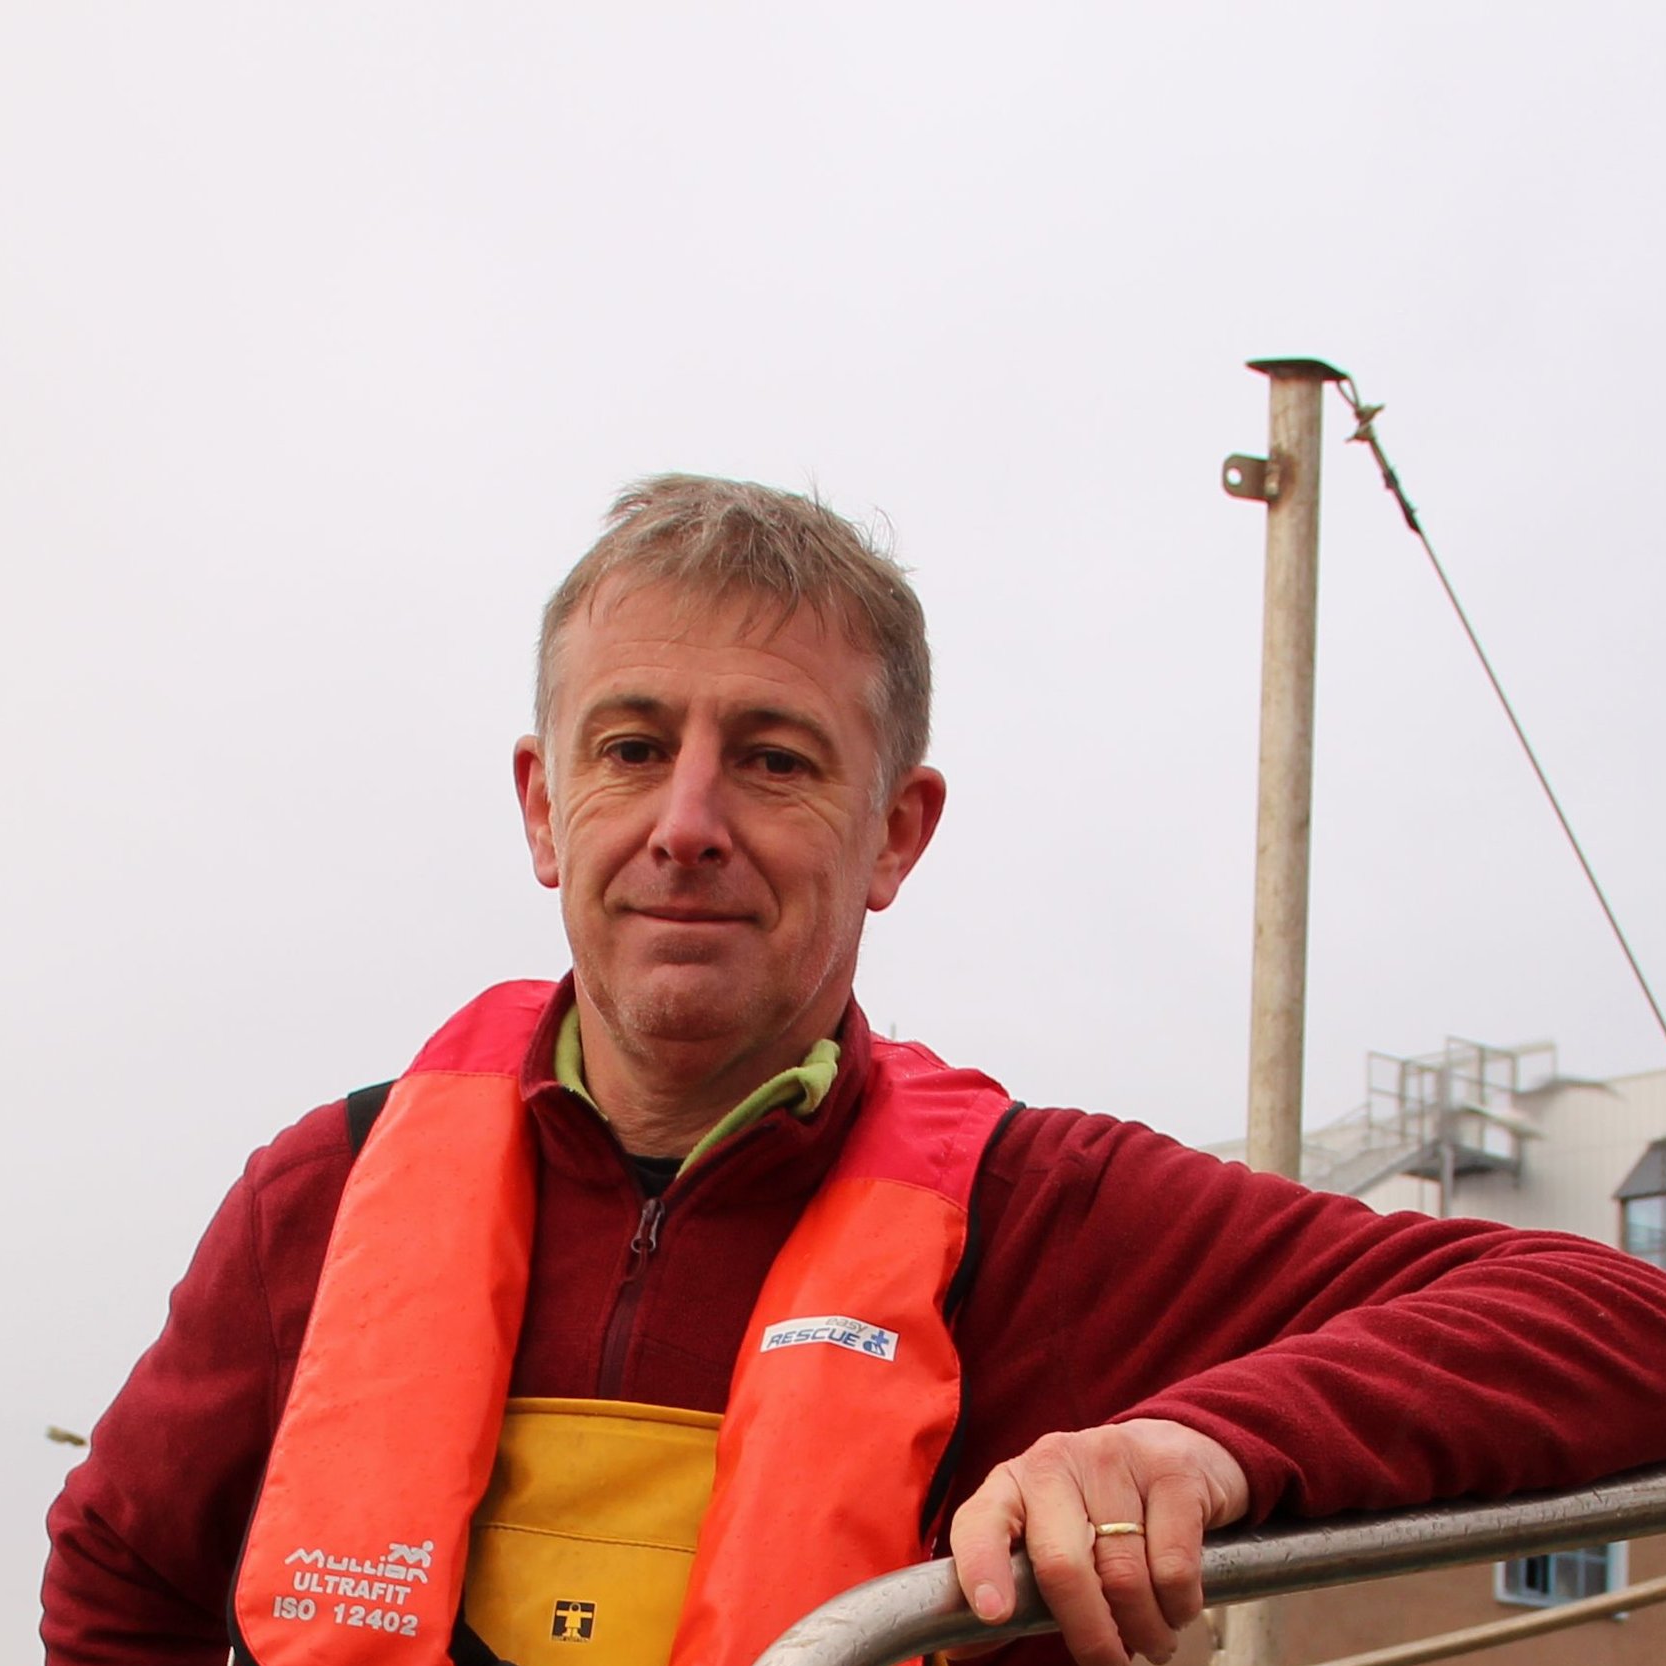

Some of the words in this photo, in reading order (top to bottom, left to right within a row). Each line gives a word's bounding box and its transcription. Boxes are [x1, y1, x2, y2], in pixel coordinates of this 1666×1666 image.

[766, 1327, 860, 1348] RESCUE
[825, 1317, 869, 1333] easy
[292, 1571, 411, 1605] ULTRAFIT
[273, 1595, 316, 1621] ISO
[334, 1603, 419, 1637] 12402
